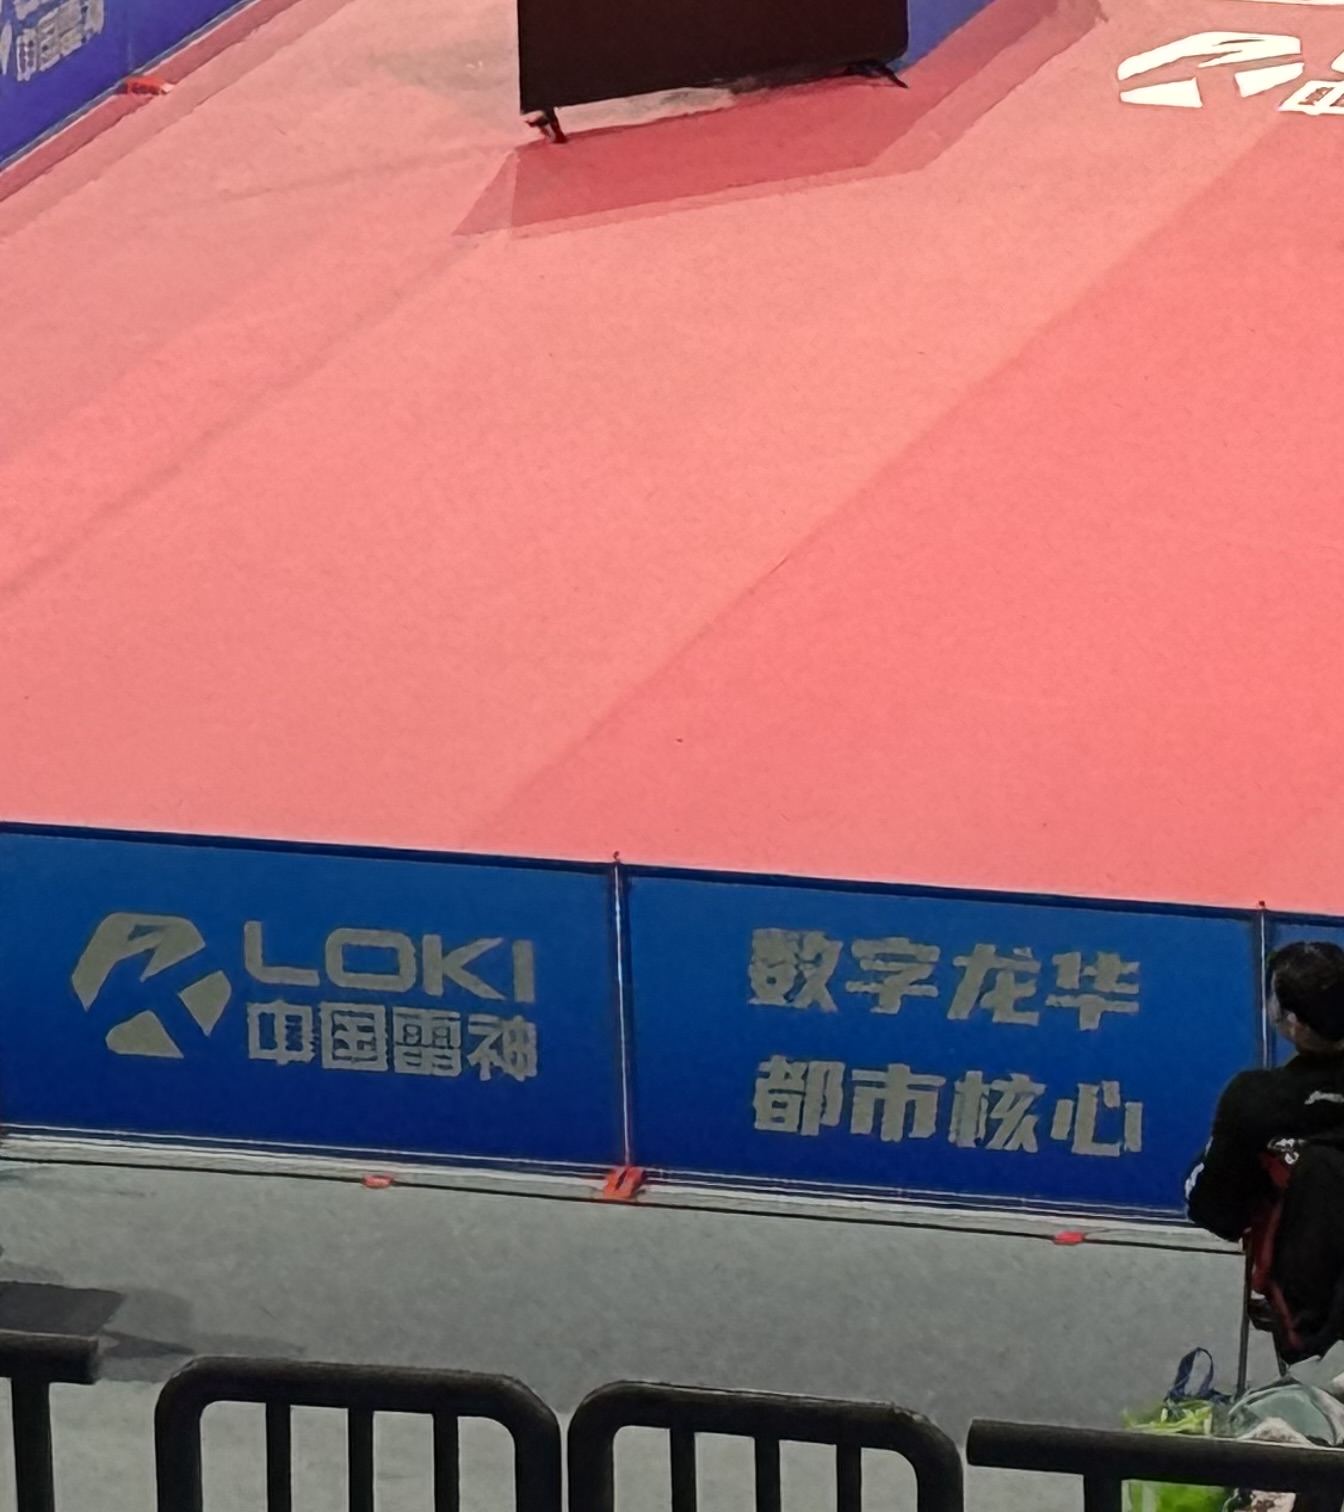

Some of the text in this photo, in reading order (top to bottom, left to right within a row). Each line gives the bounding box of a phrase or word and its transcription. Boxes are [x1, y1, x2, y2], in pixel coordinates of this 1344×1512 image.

[243, 919, 536, 1004] LOKI
[747, 927, 1141, 1032] 数字龙华
[246, 999, 538, 1083] 中国雷神
[752, 1054, 1144, 1157] 都市核心
